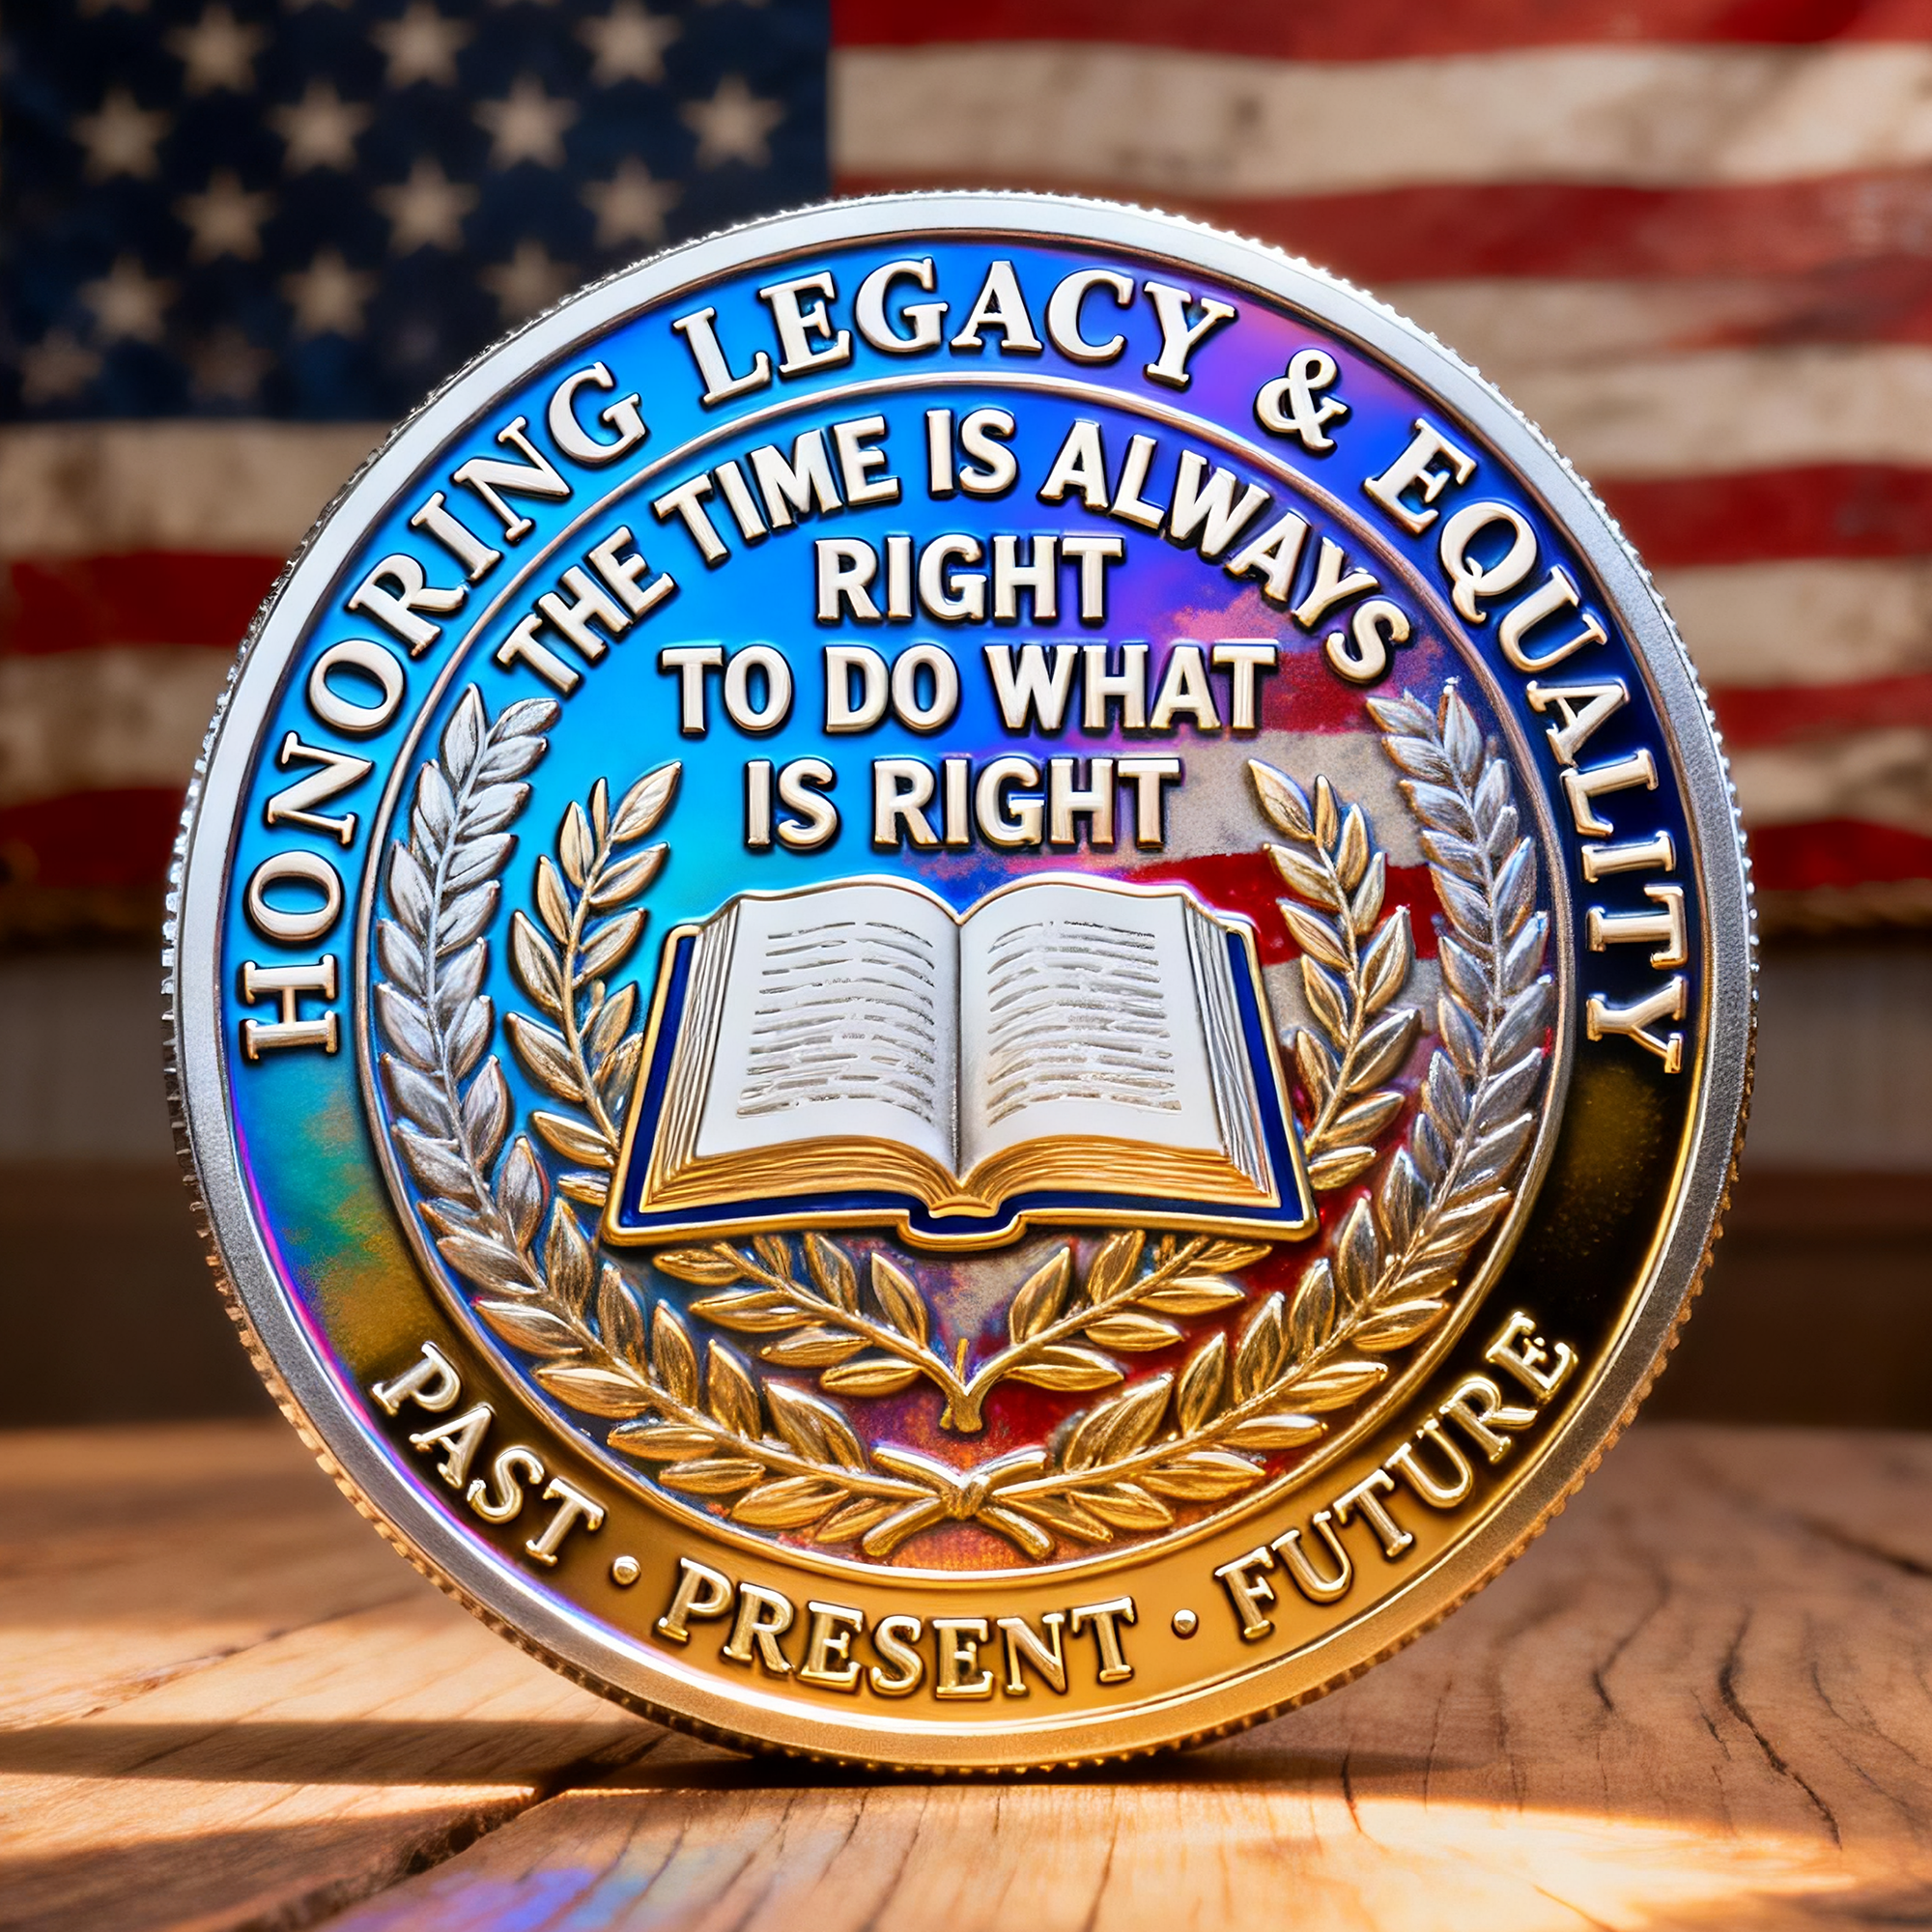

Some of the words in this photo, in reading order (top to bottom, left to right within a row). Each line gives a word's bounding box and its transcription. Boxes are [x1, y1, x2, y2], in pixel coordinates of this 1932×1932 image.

[497, 526, 675, 694] THE
[653, 415, 899, 563] TIME
[928, 409, 1015, 496] IS
[1038, 419, 1411, 683] ALWAYS
[816, 534, 1123, 621] RIGHT
[242, 360, 646, 1061] HONORING
[672, 258, 1236, 406] LEGACY
[1255, 349, 1349, 450] &
[1364, 418, 1686, 1074] EQUALITY
[662, 645, 791, 734] TO
[825, 644, 959, 731] DO
[985, 642, 1276, 732] WHAT
[746, 759, 838, 848] IS
[873, 757, 1180, 848] RIGHT
[372, 1340, 606, 1565] PAST
[658, 1557, 1135, 1698] PRESENT
[1214, 1311, 1578, 1640] FUTURE
